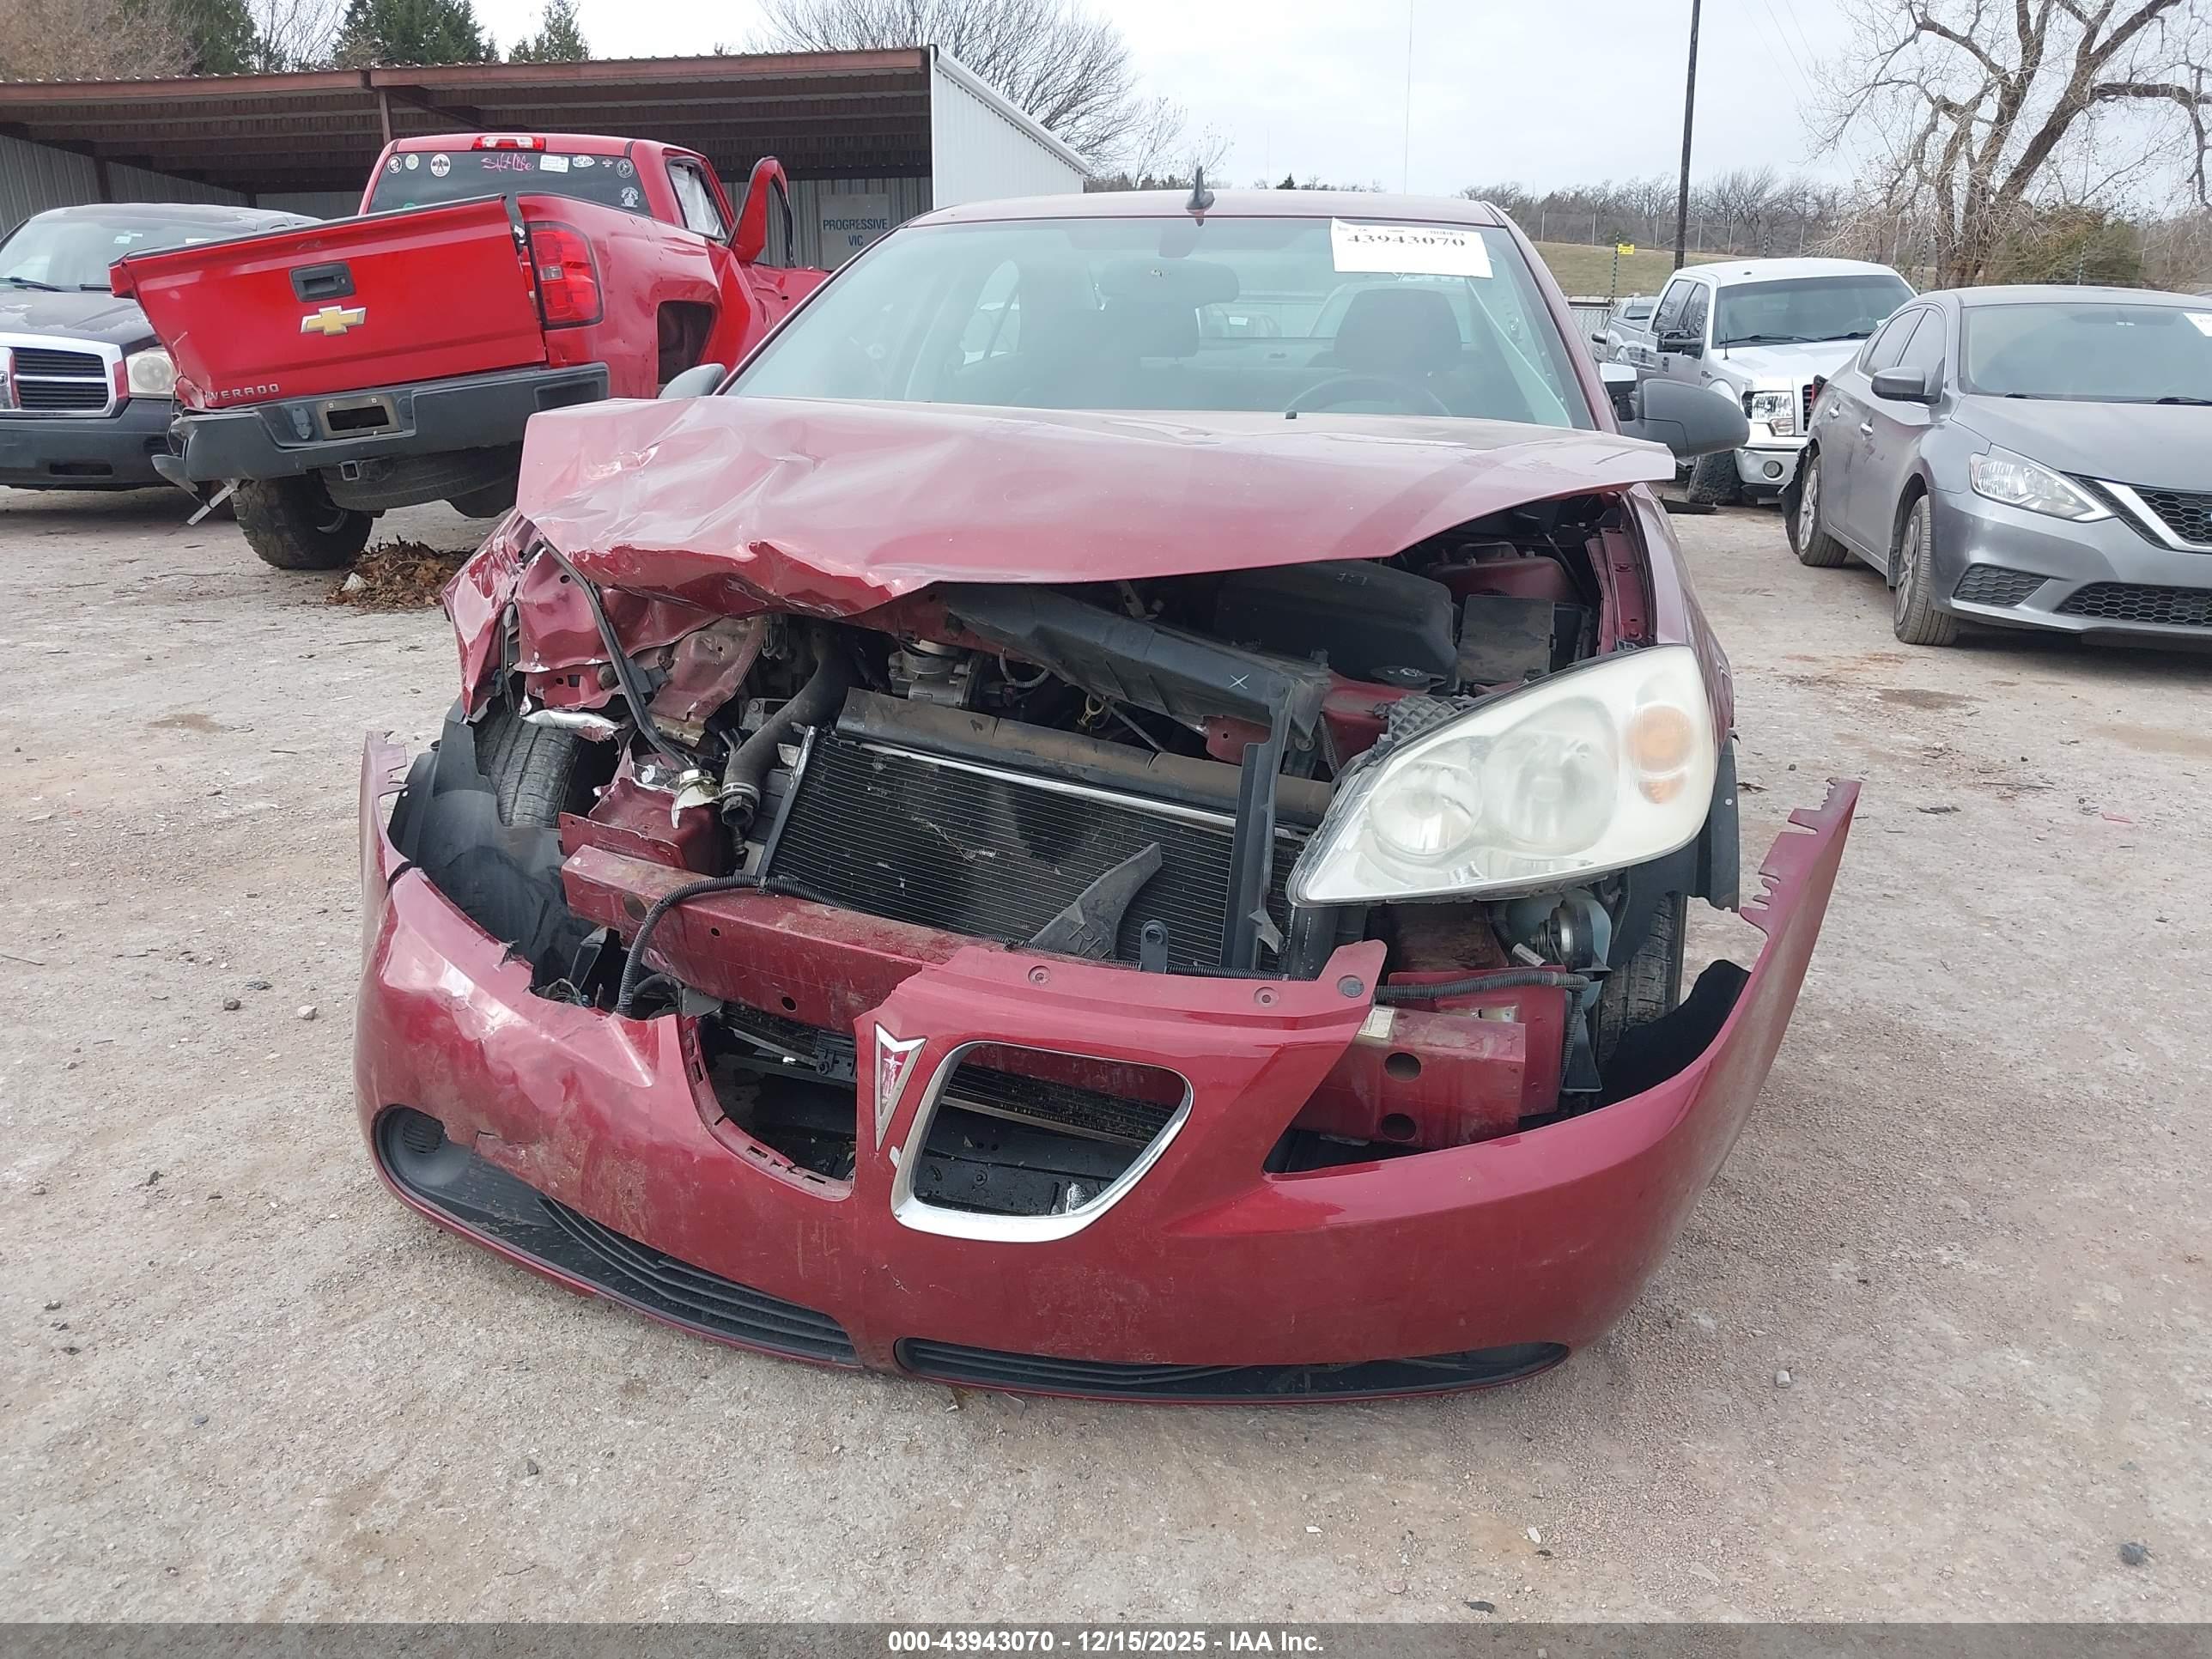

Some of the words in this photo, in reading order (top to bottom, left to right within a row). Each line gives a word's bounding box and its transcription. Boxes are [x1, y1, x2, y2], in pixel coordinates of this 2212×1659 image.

[823, 218, 888, 231] PROGRESSIVE
[848, 234, 864, 246] VIC
[1347, 234, 1466, 247] 43943070
